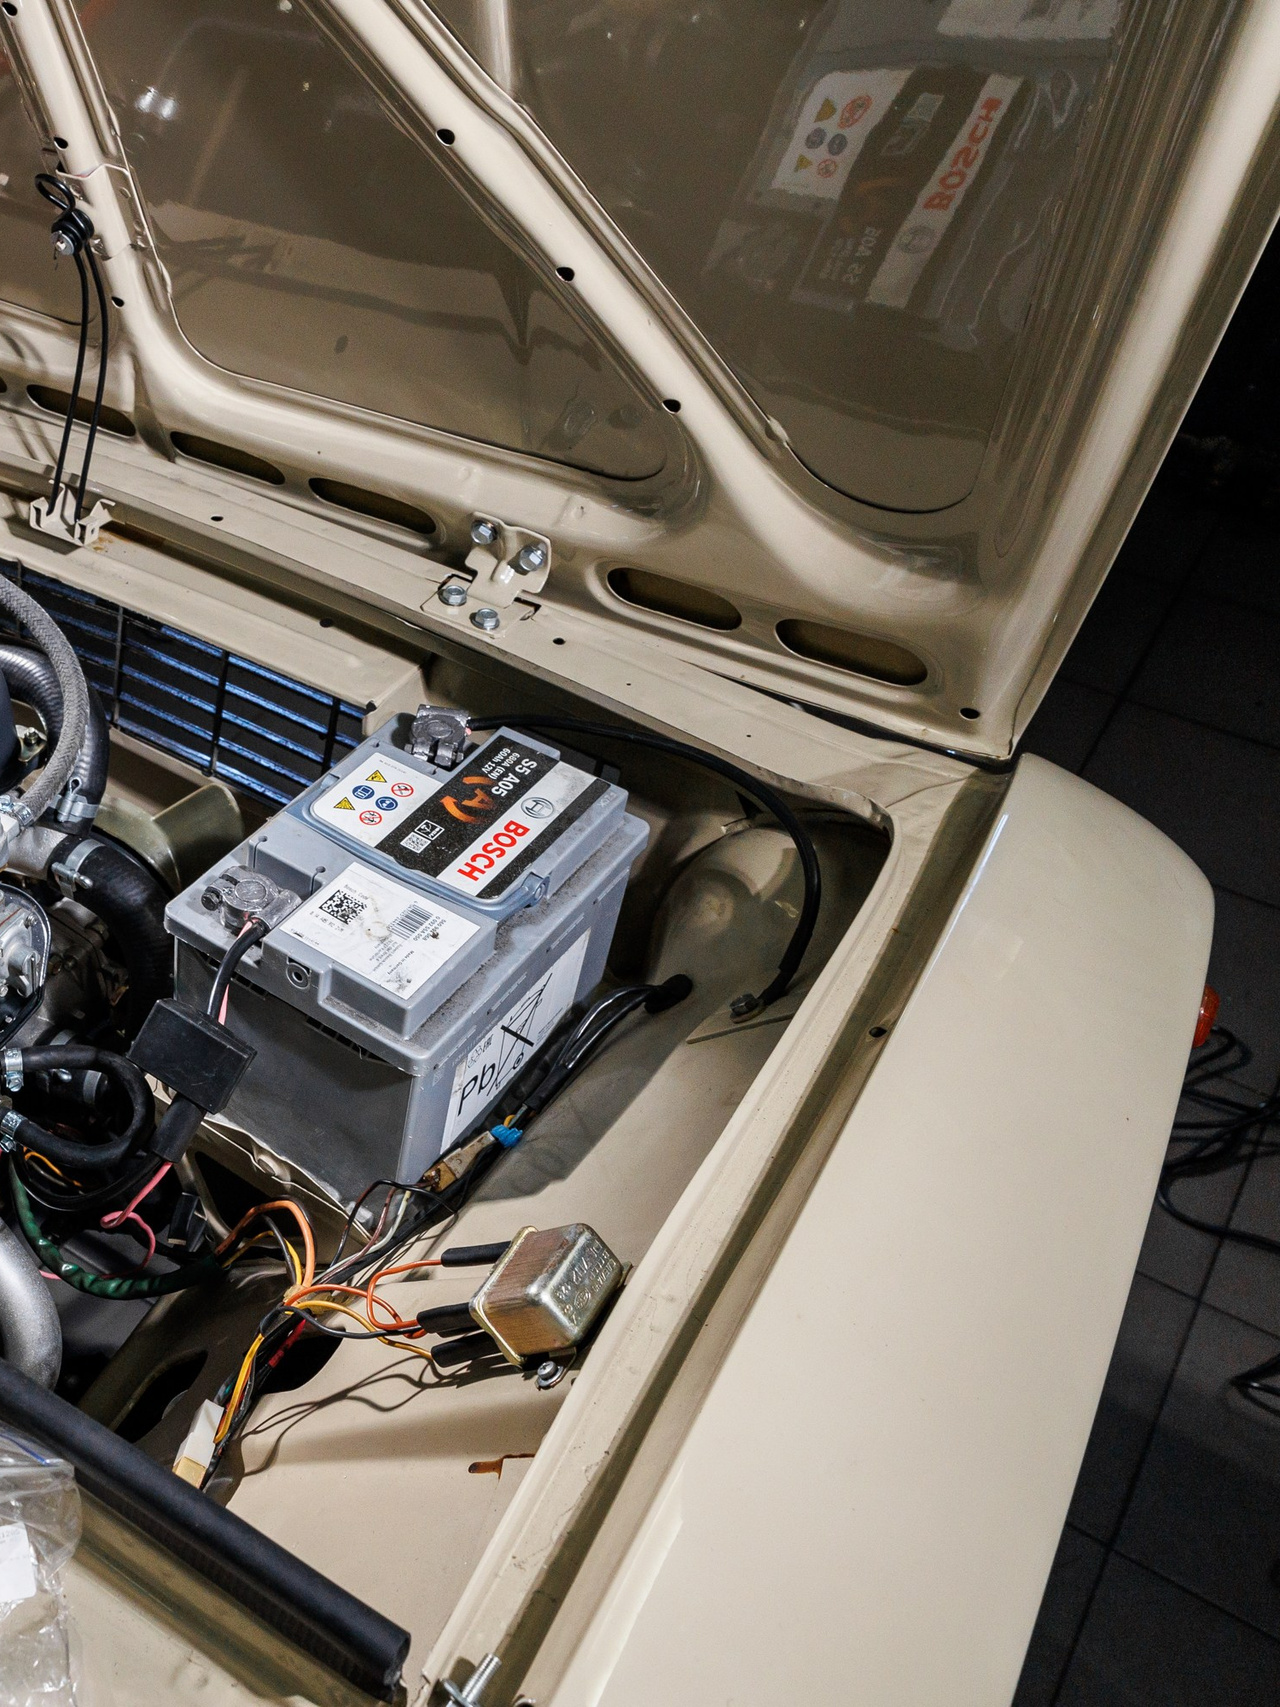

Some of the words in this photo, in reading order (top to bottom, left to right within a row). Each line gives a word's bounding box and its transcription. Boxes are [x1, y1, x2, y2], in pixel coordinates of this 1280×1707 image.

[492, 747, 511, 762] 60Ah
[501, 752, 520, 767] 680A
[481, 761, 496, 774] 12V
[487, 765, 506, 780] (EN)
[515, 758, 538, 775] S5
[491, 772, 520, 797] A05
[457, 820, 531, 881] BOSCH
[404, 950, 415, 959] Made
[387, 961, 403, 975] Germany
[457, 1062, 496, 1116] Pb
